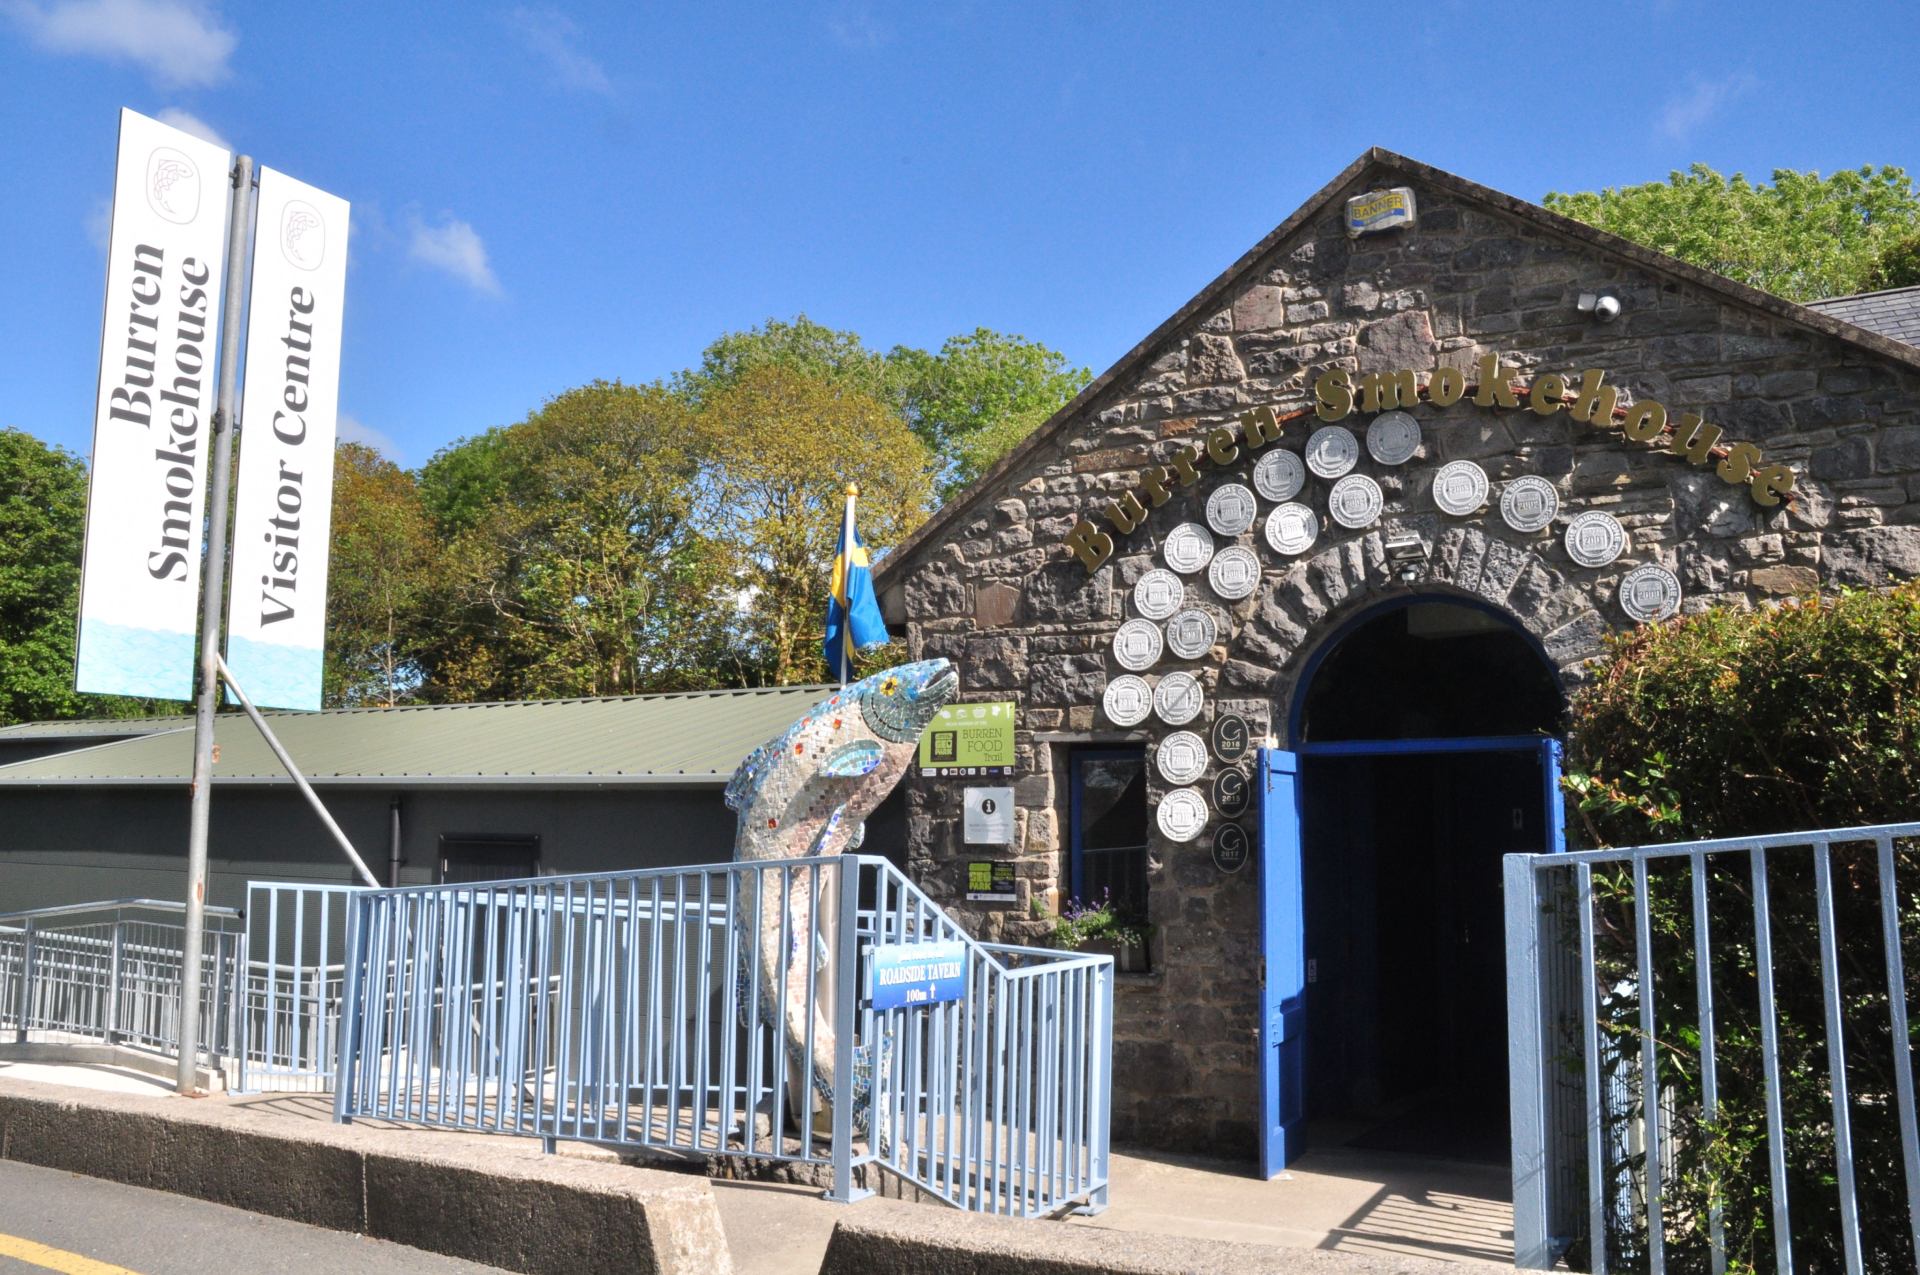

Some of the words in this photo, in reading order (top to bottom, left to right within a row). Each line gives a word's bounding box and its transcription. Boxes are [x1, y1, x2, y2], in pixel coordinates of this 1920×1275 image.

[1354, 197, 1403, 218] BANNER
[109, 242, 164, 430] Burren
[272, 286, 315, 446] Centre
[148, 256, 209, 582] Smokehouse
[1063, 405, 1284, 574] Burren
[1315, 352, 1794, 506] Smokehouse
[1285, 452, 1303, 477] GUIDES
[1435, 478, 1443, 494] THE
[1439, 462, 1486, 488] BRIDGESTONE
[1451, 485, 1471, 494] 2003
[1237, 487, 1254, 512] GUIDES
[1331, 491, 1339, 508] THE
[1335, 476, 1381, 502] BRIDGESTONE
[1503, 493, 1512, 510] THE
[1507, 477, 1557, 506] BRIDGESTONE
[1222, 508, 1238, 516] 2015
[1518, 502, 1540, 510] 2002
[1567, 527, 1577, 545] THE
[1572, 513, 1622, 541] BRIDGESTONE
[1584, 536, 1604, 545] 2001
[261, 458, 304, 629] Visitor
[1211, 561, 1220, 577] THE
[1215, 548, 1259, 575] BRIDGESTONE
[1226, 570, 1243, 578] 2006
[1165, 572, 1182, 598] GUIDES
[1621, 582, 1631, 600] THE
[1626, 566, 1679, 596] BRIDGESTONE
[1115, 633, 1123, 649] THE
[1120, 621, 1161, 648] BRIDGESTONE
[1169, 621, 1177, 638] THE
[1173, 609, 1215, 635] BRIDGESTONE
[1110, 676, 1151, 703] BRIDGESTONE
[1156, 686, 1164, 702] THE
[963, 728, 1002, 739] BURREN
[968, 740, 1002, 752] FOOD
[984, 753, 1002, 761] Trail
[1159, 746, 1168, 761] THE
[1164, 733, 1206, 762] BRIDGESTONE
[1164, 790, 1207, 819] BRIDGESTONE
[969, 872, 991, 882] GEO
[969, 882, 991, 890] PARK
[880, 964, 926, 985] ROADSIDE
[928, 962, 961, 980] TAVERN
[906, 989, 927, 1003] 100m
